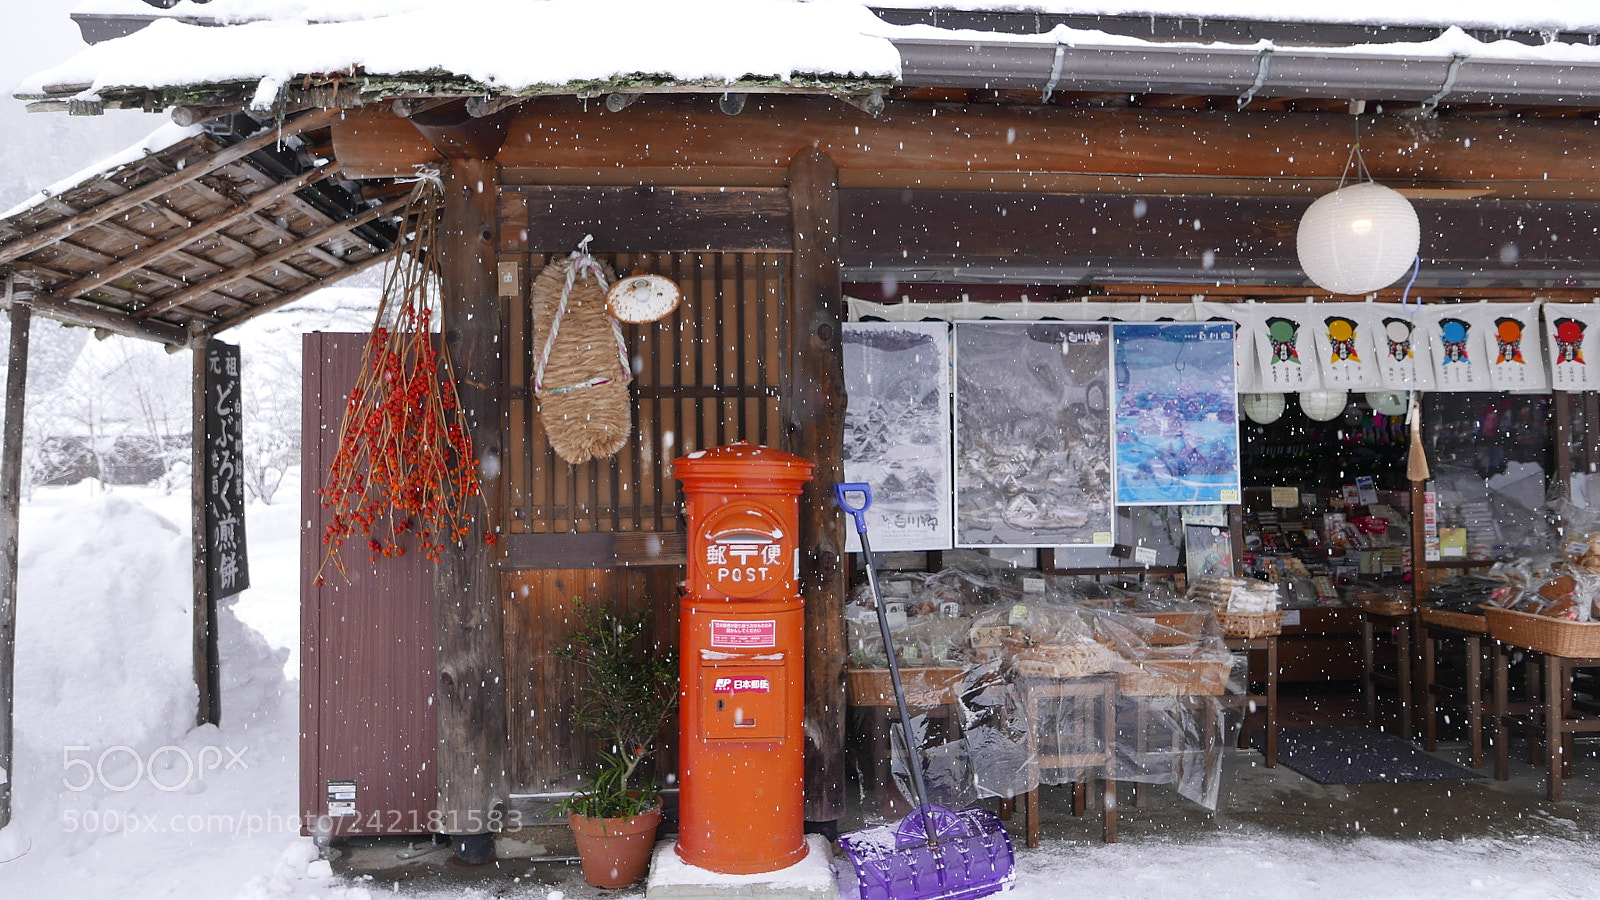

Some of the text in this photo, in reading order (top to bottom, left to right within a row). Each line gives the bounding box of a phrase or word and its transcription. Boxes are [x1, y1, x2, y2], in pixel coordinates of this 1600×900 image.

[209, 350, 238, 376] 元祖
[215, 380, 239, 589] どぶろく煎餅
[717, 567, 769, 582] POST
[733, 679, 769, 690] 日本郵便
